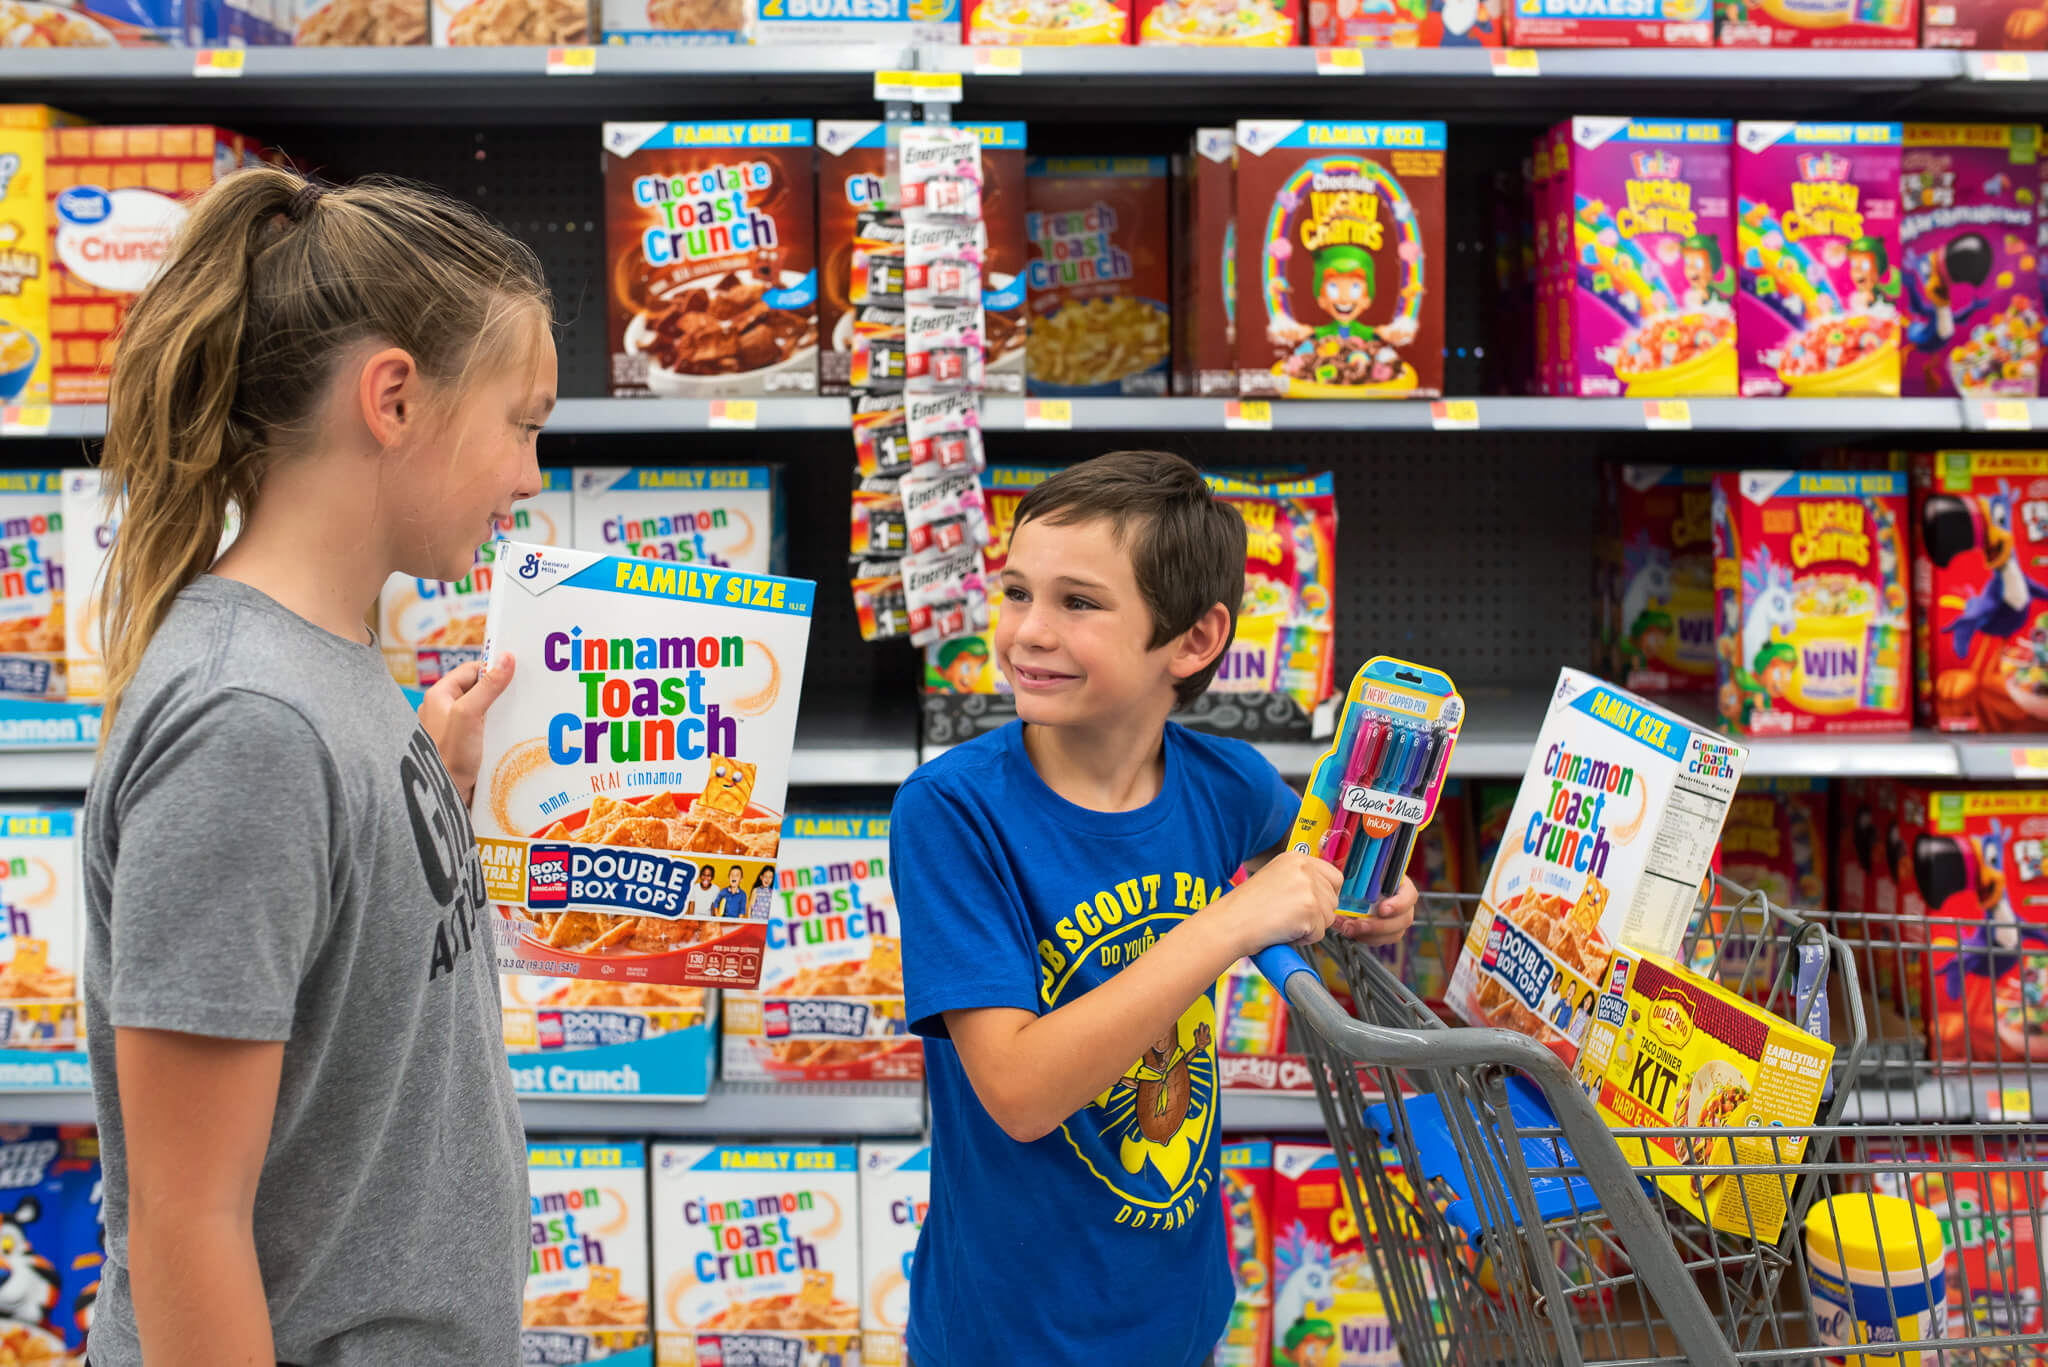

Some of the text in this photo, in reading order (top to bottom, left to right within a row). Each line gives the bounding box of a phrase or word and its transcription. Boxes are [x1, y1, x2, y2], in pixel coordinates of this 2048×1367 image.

[673, 124, 791, 145] FAMILY SIZE
[1308, 126, 1425, 146] FAMILY SIZE
[637, 165, 768, 203] Chocolate
[661, 191, 748, 230] Toast
[648, 211, 773, 262] Crunch
[639, 471, 750, 488] FAMILY SIZE
[602, 508, 727, 544] Cinnamon
[541, 567, 558, 575] Mills
[542, 559, 570, 570] General
[615, 561, 787, 609] FAMILY SIZE
[544, 625, 744, 672] Cinnamon
[1803, 648, 1857, 677] WIN
[578, 669, 706, 719] Toast
[1367, 687, 1388, 705] NEW!
[1413, 699, 1428, 713] PEN
[547, 704, 738, 766] Crunch
[1590, 691, 1672, 749] FAMILY SIZE
[1692, 739, 1739, 757] Cinnamon
[1699, 750, 1729, 767] Toast
[590, 768, 683, 793] REAL cinnamon
[1544, 740, 1634, 797] Cinnamon
[1688, 759, 1734, 779] Crunch
[1348, 787, 1423, 820] Paper Mate
[1546, 780, 1606, 834] Toast
[794, 818, 863, 837] FAMILY
[1366, 816, 1393, 833] InkJoy
[1523, 811, 1610, 879] Crunch
[484, 867, 510, 882] TRA
[529, 860, 564, 878] BOX
[534, 871, 568, 885] TOPS
[572, 854, 688, 892] DOUBLE
[571, 881, 680, 912] BOX TOPS
[780, 882, 863, 919] Toast
[1055, 871, 1222, 955] SCOUT PA
[766, 903, 887, 950] Crunch
[1101, 945, 1121, 967] DO
[1503, 930, 1550, 988] DOUBLE
[1496, 952, 1540, 1003] BOX TOPS
[1600, 997, 1627, 1017] DOUBLE
[1641, 1036, 1682, 1073] TACO DINNER
[1763, 1055, 1777, 1067] FOR
[1779, 1060, 1798, 1072] YOUR
[1766, 1043, 1819, 1068] EARN EXTRA
[549, 1064, 640, 1092] Crunch
[1628, 1049, 1679, 1115] KIT
[1611, 1091, 1643, 1126] HARD &
[580, 1149, 622, 1166] SIZE
[720, 1152, 836, 1169] FAMILY SIZE
[683, 1190, 815, 1225] Cinnamon
[532, 1212, 580, 1245] ast
[708, 1216, 793, 1252] Toast
[695, 1236, 818, 1283] Crunch
